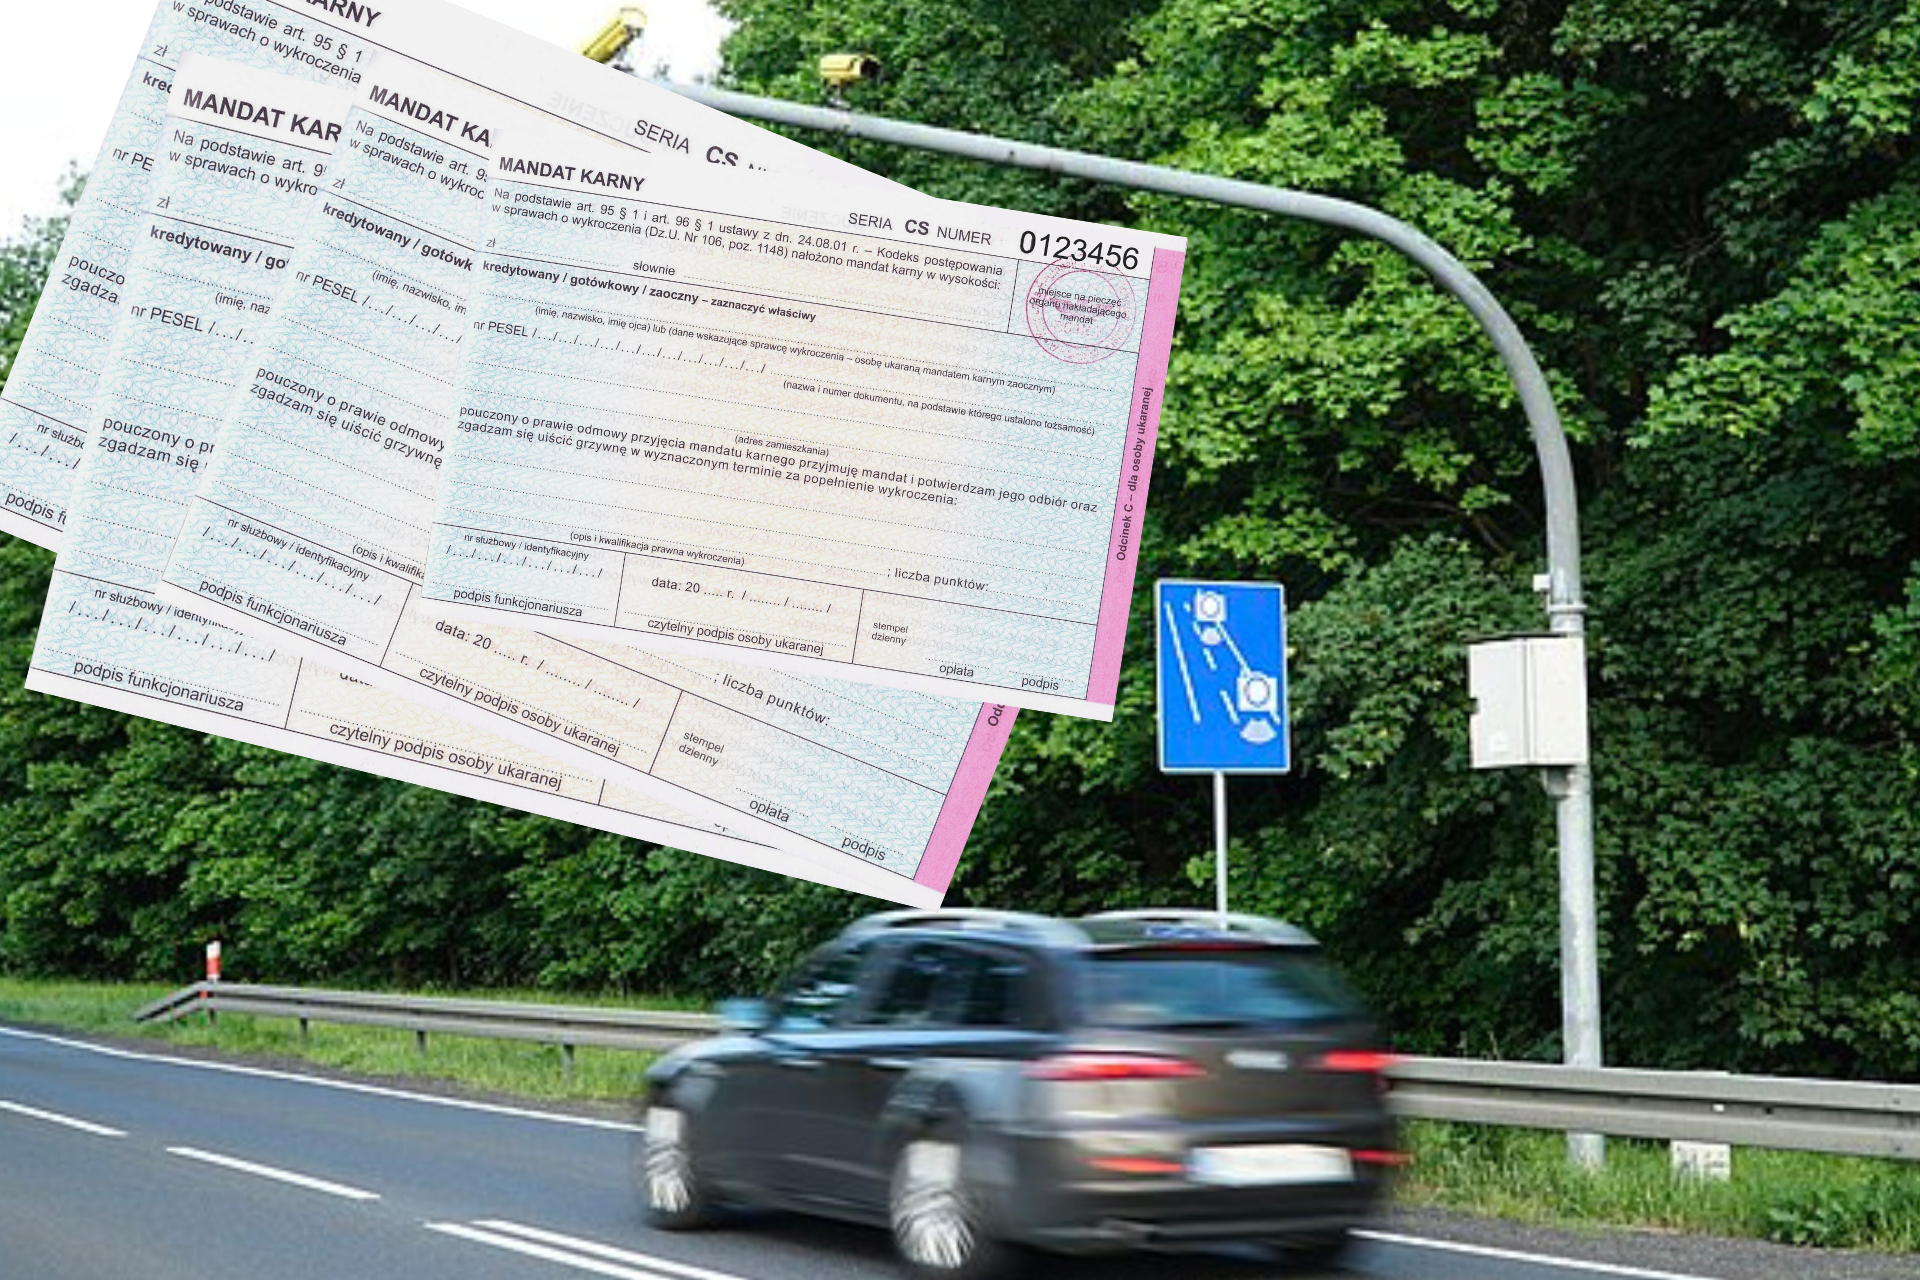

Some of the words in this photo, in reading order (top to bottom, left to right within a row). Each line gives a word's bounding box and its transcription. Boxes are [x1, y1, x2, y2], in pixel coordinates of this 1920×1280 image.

[304, 0, 382, 28] ARNY
[171, 0, 185, 12] w
[187, 6, 256, 42] sprawach
[259, 36, 270, 47] o
[273, 40, 362, 84] wykroczenia
[283, 24, 305, 42] art.
[313, 33, 333, 51] 95
[355, 50, 363, 63] 1
[183, 88, 286, 128] MANDAT
[369, 85, 459, 132] MANDAT
[460, 121, 490, 148] KA
[355, 120, 374, 137] Na
[377, 131, 444, 165] podstawie
[448, 160, 469, 176] art.
[634, 119, 690, 154] SERIA
[499, 156, 577, 181] MANDAT
[580, 168, 646, 192] KARNY
[150, 224, 253, 264] kredytowany
[322, 202, 412, 248] kredytowany
[420, 244, 473, 272] gotówk
[486, 238, 496, 248] zł
[494, 187, 510, 200] Na
[514, 193, 572, 209] podstawie
[576, 202, 594, 213] art.
[600, 204, 615, 216] 95
[633, 209, 638, 220] 1
[651, 214, 670, 225] art.
[675, 215, 690, 228] 96
[708, 221, 713, 231] 1
[719, 224, 759, 241] ustawy
[763, 231, 771, 240] z
[775, 231, 792, 244] dn.
[797, 234, 847, 252] 24.08.01
[877, 246, 919, 263] Kodeks
[923, 256, 1003, 276] postępowania
[503, 205, 558, 222] sprawach
[561, 215, 569, 223] o
[572, 216, 642, 235] wykroczenia
[645, 225, 680, 241] (Dz.U.
[684, 231, 699, 243] Nr
[703, 234, 725, 248] 106,
[728, 240, 752, 252] poz.
[757, 243, 788, 259] 1148)
[791, 250, 843, 266] nałożono
[846, 259, 889, 273] mandat
[891, 263, 924, 280] karny
[926, 271, 937, 280] w
[939, 273, 1001, 290] wysokości:
[848, 212, 893, 231] SERIA
[904, 219, 930, 236] CS
[937, 226, 992, 246] NUMER
[1019, 230, 1140, 270] 0123456
[68, 256, 125, 286] pouczo
[632, 260, 676, 276] słownie
[483, 260, 560, 284] kredytowany
[569, 276, 640, 296] gotówkowy
[648, 288, 699, 305] zaoczny
[710, 298, 766, 315] zaznaczyć
[768, 306, 817, 323] właściwy
[473, 321, 486, 330] nr
[488, 321, 528, 337] PESEL
[250, 383, 314, 416] zgadzam
[316, 410, 338, 428] się
[341, 419, 382, 443] uiścić
[383, 437, 443, 470] grzywnę
[255, 367, 325, 403] pouczony
[327, 396, 336, 406] o
[338, 400, 386, 426] prawie
[389, 421, 445, 453] odmowy
[783, 380, 815, 392] (nazwa
[822, 387, 852, 397] numer
[853, 390, 905, 407] dokumentu,
[907, 400, 919, 408] na
[920, 402, 967, 416] podstawie
[968, 408, 1002, 422] którego
[1004, 415, 1042, 427] ustalono
[1044, 420, 1095, 437] tożsamość)
[1136, 387, 1154, 435] ukaranej
[457, 421, 513, 437] zgadzam
[516, 428, 534, 443] się
[537, 432, 573, 446] uiścić
[575, 439, 627, 457] grzywnę
[630, 447, 641, 456] w
[644, 450, 729, 471] wyznaczonym
[733, 461, 782, 479] terminie
[785, 471, 800, 481] za
[803, 474, 875, 493] popełnienie
[878, 485, 958, 506] wykroczenia:
[459, 407, 519, 425] pouczony
[521, 416, 530, 425] o
[532, 418, 574, 432] prawie
[577, 424, 628, 442] odmowy
[630, 433, 686, 449] przyjęcia
[689, 442, 742, 458] mandatu
[745, 448, 796, 467] karnego
[798, 459, 858, 478] przyjmuję
[861, 469, 908, 484] mandat
[917, 477, 996, 497] potwierdzam
[997, 490, 1025, 503] jego
[1028, 494, 1068, 508] odbiór
[1070, 501, 1098, 513] oraz
[734, 434, 763, 446] (adres
[765, 441, 829, 458] zamieszkania)
[1132, 437, 1146, 472] osoby
[1127, 474, 1138, 492] dla
[1123, 503, 1134, 513] C
[1116, 515, 1132, 561] Odcinek
[651, 577, 681, 591] data:
[684, 581, 700, 594] 20
[894, 567, 930, 583] liczba
[933, 576, 989, 592] punktów:
[453, 589, 491, 603] podpis
[494, 593, 583, 617] funkcjonariusza
[647, 619, 694, 636] czytelny
[696, 627, 735, 641] podpis
[737, 633, 772, 648] osoby
[775, 638, 824, 657] ukaranej
[871, 632, 907, 646] dzienny
[873, 622, 909, 634] stempel
[73, 662, 124, 683] podpis
[128, 671, 244, 712] funkcjonariusza
[939, 664, 974, 678] opłata
[1021, 677, 1059, 691] podpis
[419, 668, 473, 698] czytelny
[473, 690, 519, 715] podpis
[521, 709, 562, 733] osoby
[563, 725, 621, 758] ukaranej
[722, 673, 764, 700] liczba
[766, 694, 830, 726] punktów:
[329, 724, 391, 750] czytelny
[393, 739, 444, 760] podpis
[448, 752, 494, 775] osoby
[497, 763, 563, 792] ukaranej
[678, 744, 719, 767] dzienny
[683, 732, 725, 753] stempel
[749, 800, 790, 823] opłata
[841, 837, 886, 861] podpis
